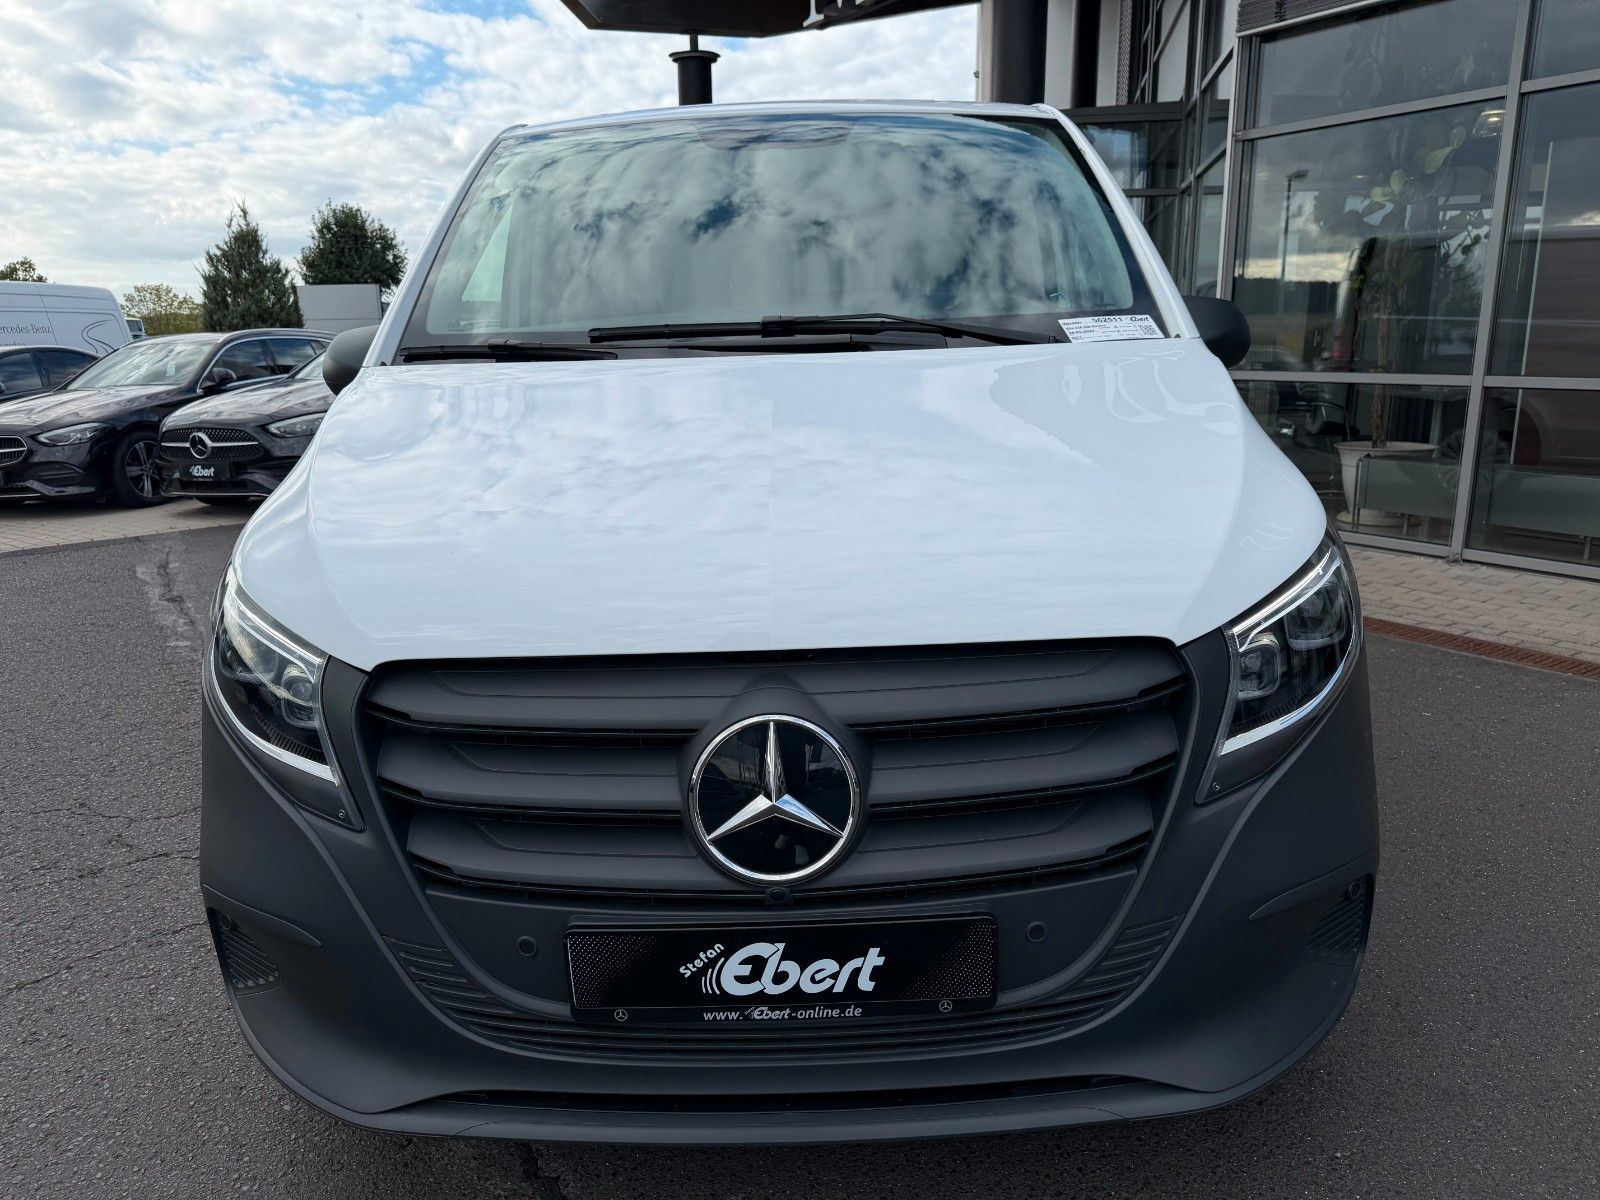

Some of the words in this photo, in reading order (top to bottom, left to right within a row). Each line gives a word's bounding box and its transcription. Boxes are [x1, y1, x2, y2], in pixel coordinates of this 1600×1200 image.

[0, 323, 51, 334] ercedes-Benz
[193, 465, 214, 476] Ebert
[679, 943, 725, 979] Stefan
[720, 941, 886, 997] Ebert
